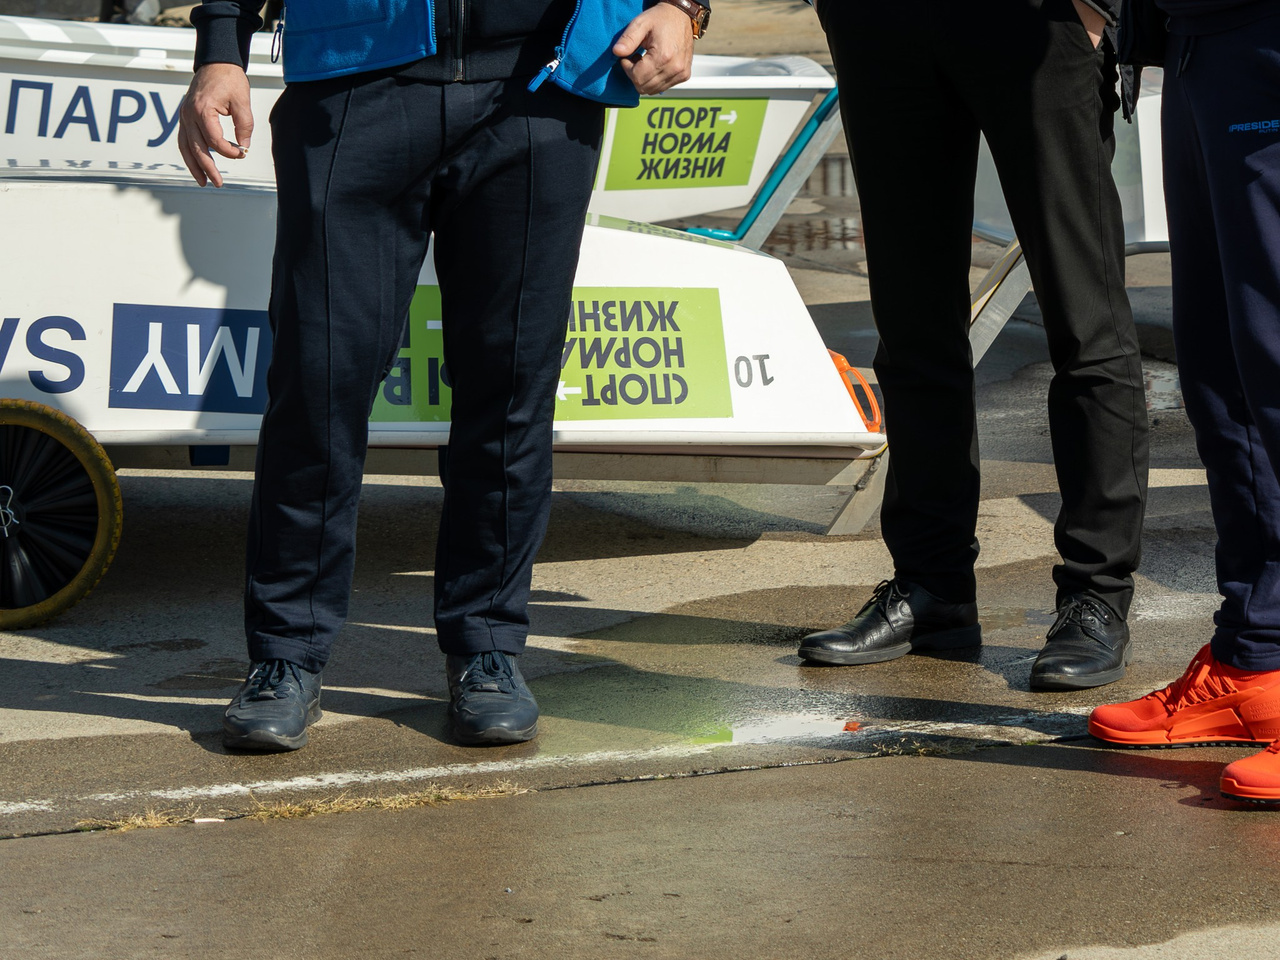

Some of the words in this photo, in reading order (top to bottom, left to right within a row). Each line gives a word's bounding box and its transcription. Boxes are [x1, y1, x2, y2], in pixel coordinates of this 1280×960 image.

[5, 79, 190, 148] ПАРУ
[647, 107, 722, 129] СПОРТ
[641, 132, 732, 155] НОРМА
[636, 156, 726, 180] ЖИЗНИ
[122, 321, 260, 398] MY
[734, 354, 774, 388] 10
[582, 373, 689, 406] СПОРТ
